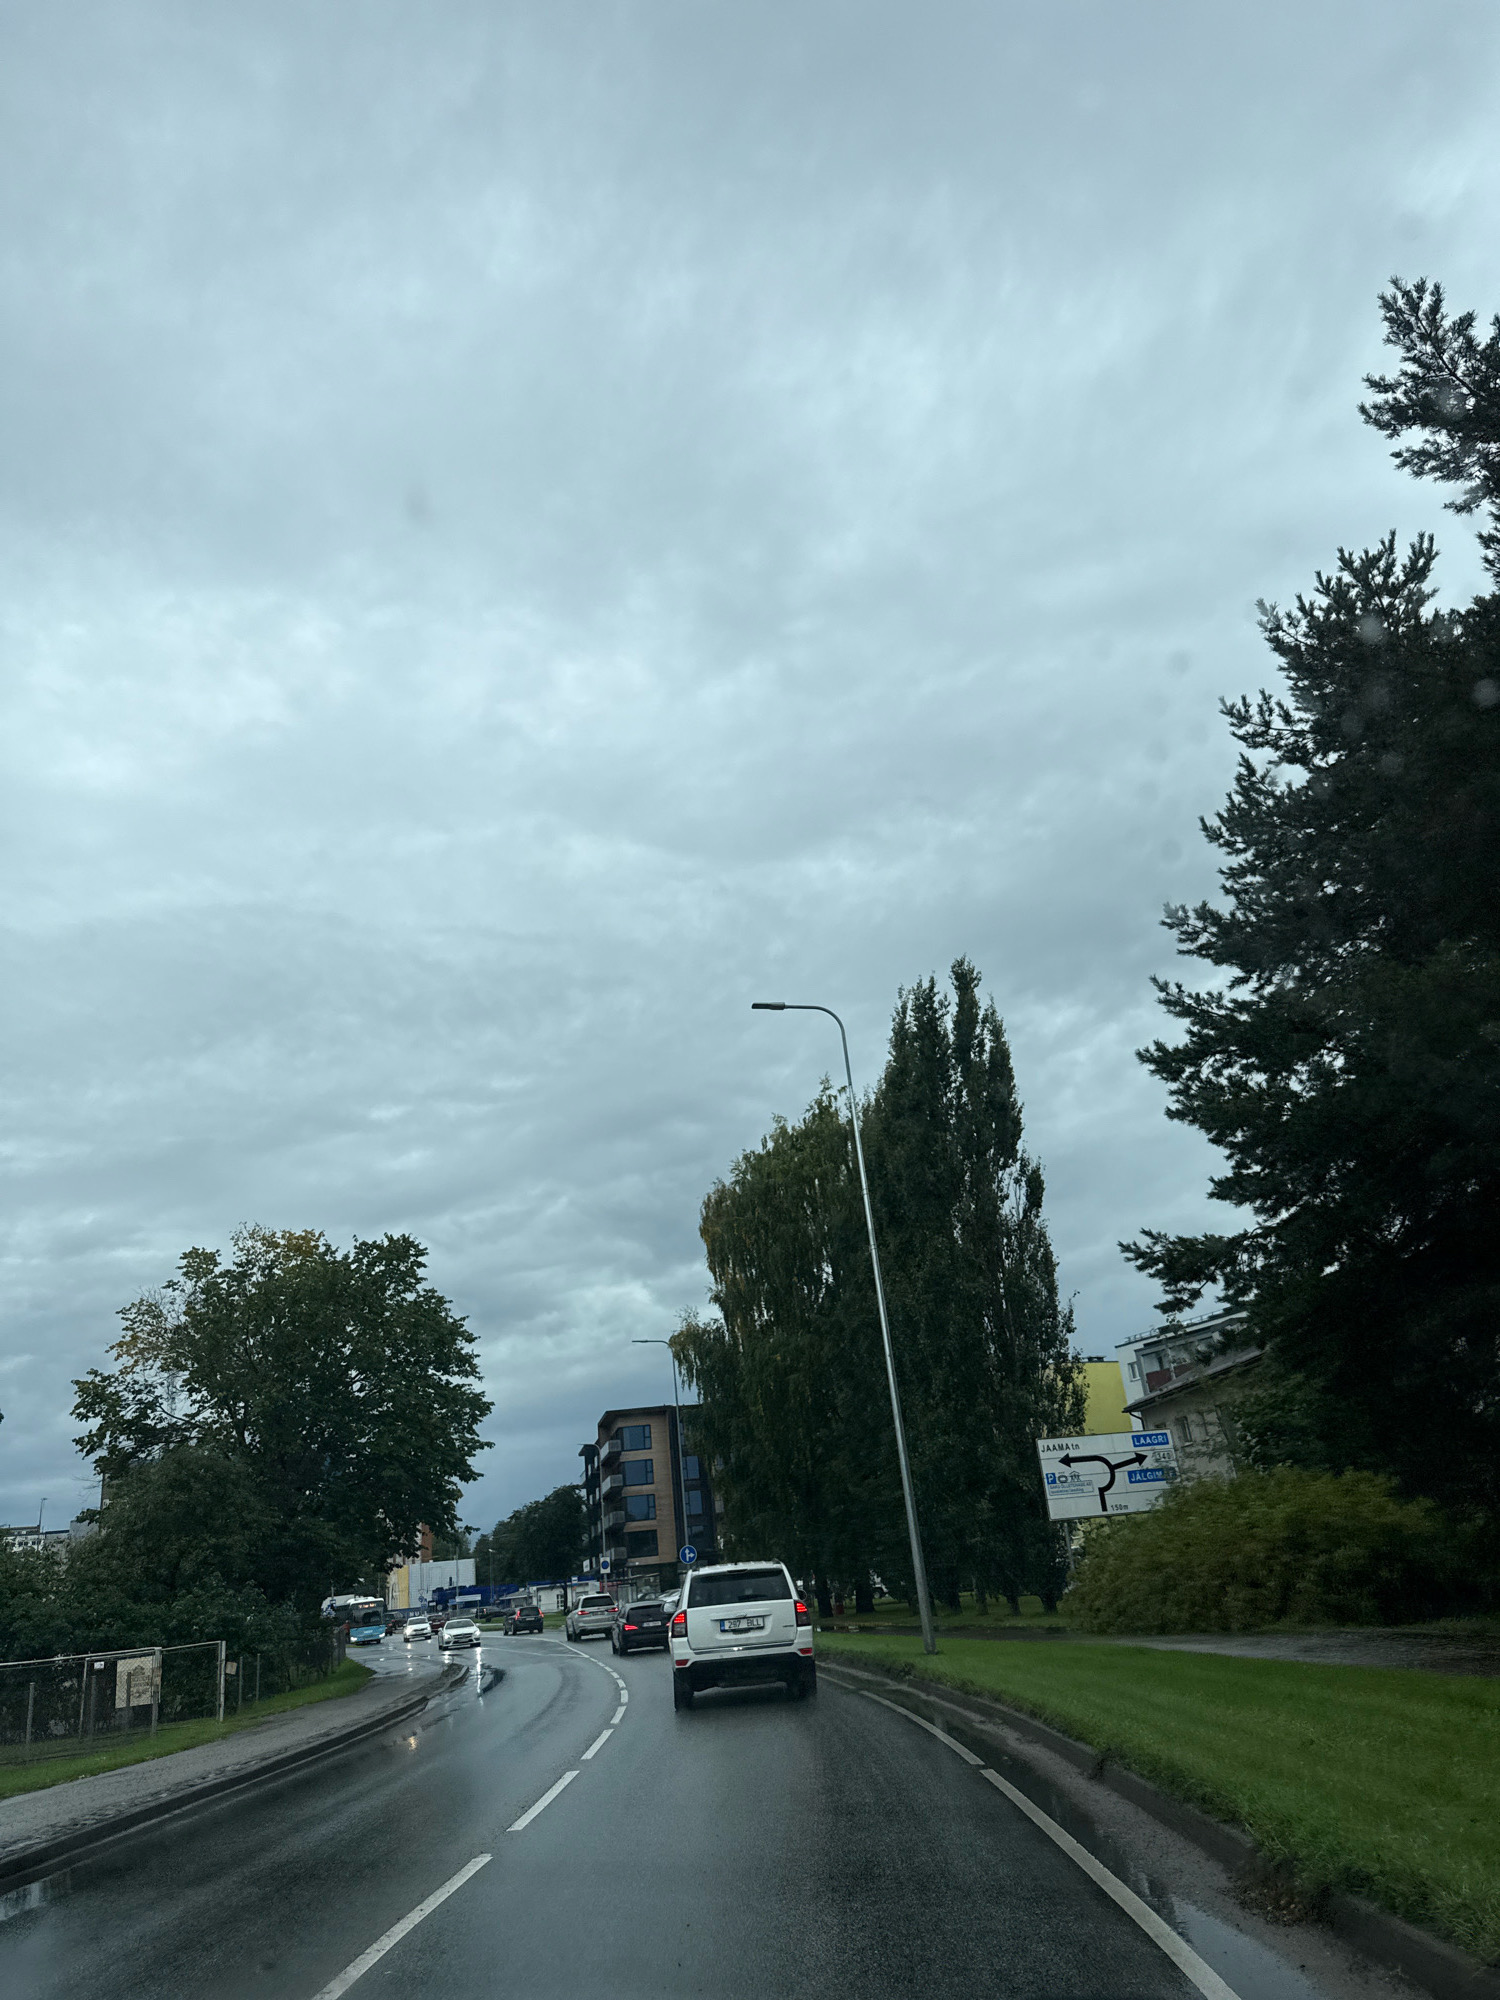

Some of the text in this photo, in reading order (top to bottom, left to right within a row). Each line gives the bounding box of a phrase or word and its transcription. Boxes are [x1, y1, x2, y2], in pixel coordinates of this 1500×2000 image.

[1134, 1435, 1167, 1445] LAAGRI
[1041, 1442, 1081, 1453] JAAMA tn
[1048, 1473, 1055, 1483] P
[1131, 1470, 1174, 1482] JÄLGIM
[728, 1619, 741, 1629] 297
